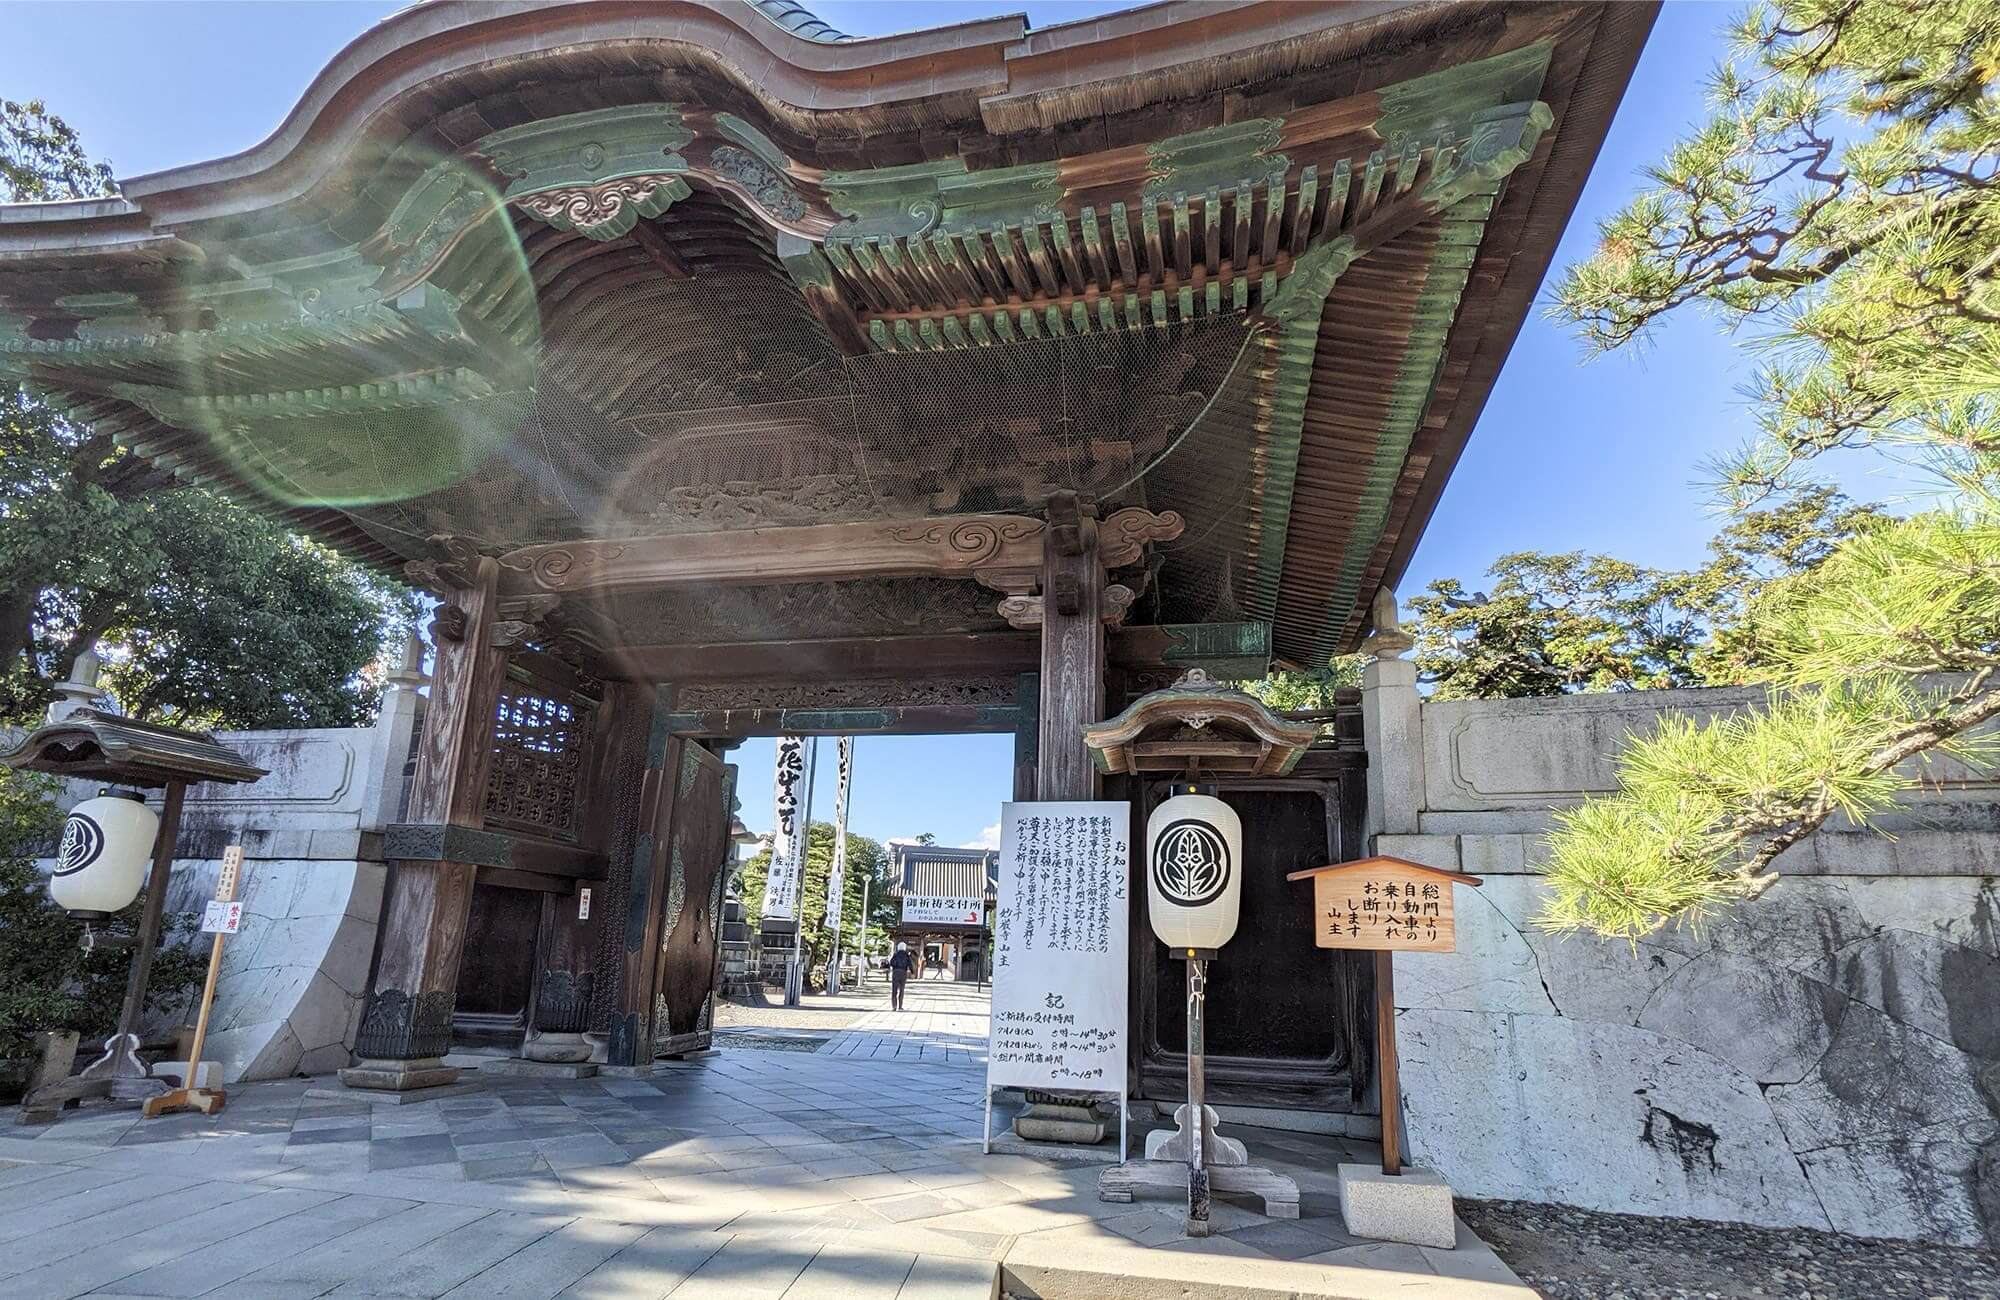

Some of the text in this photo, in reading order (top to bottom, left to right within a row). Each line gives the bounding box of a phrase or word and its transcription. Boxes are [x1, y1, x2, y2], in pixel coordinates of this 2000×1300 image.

[1012, 817, 1028, 921] 心からお祈り申し上げます
[1038, 818, 1052, 927] よろしくお願い申し上げます
[1060, 816, 1075, 951] 対応させて頂きますのでご了承下さい
[1074, 817, 1088, 951] 当山においては当分の間下記のように
[1085, 816, 1100, 952] 緊急事態宣言は解除されましたが
[1112, 841, 1127, 900] お知らせ
[906, 897, 981, 910] 御祈祷受付所
[1328, 908, 1342, 935] 山主
[1346, 898, 1361, 938] します
[1363, 882, 1381, 926] お断り
[1382, 882, 1401, 940] 乗り入れ
[1402, 882, 1419, 941] 自動車の
[1422, 883, 1440, 942] 総門より
[999, 1011, 1075, 1025] ご祈祷の受付時間
[1044, 992, 1065, 1009] 記
